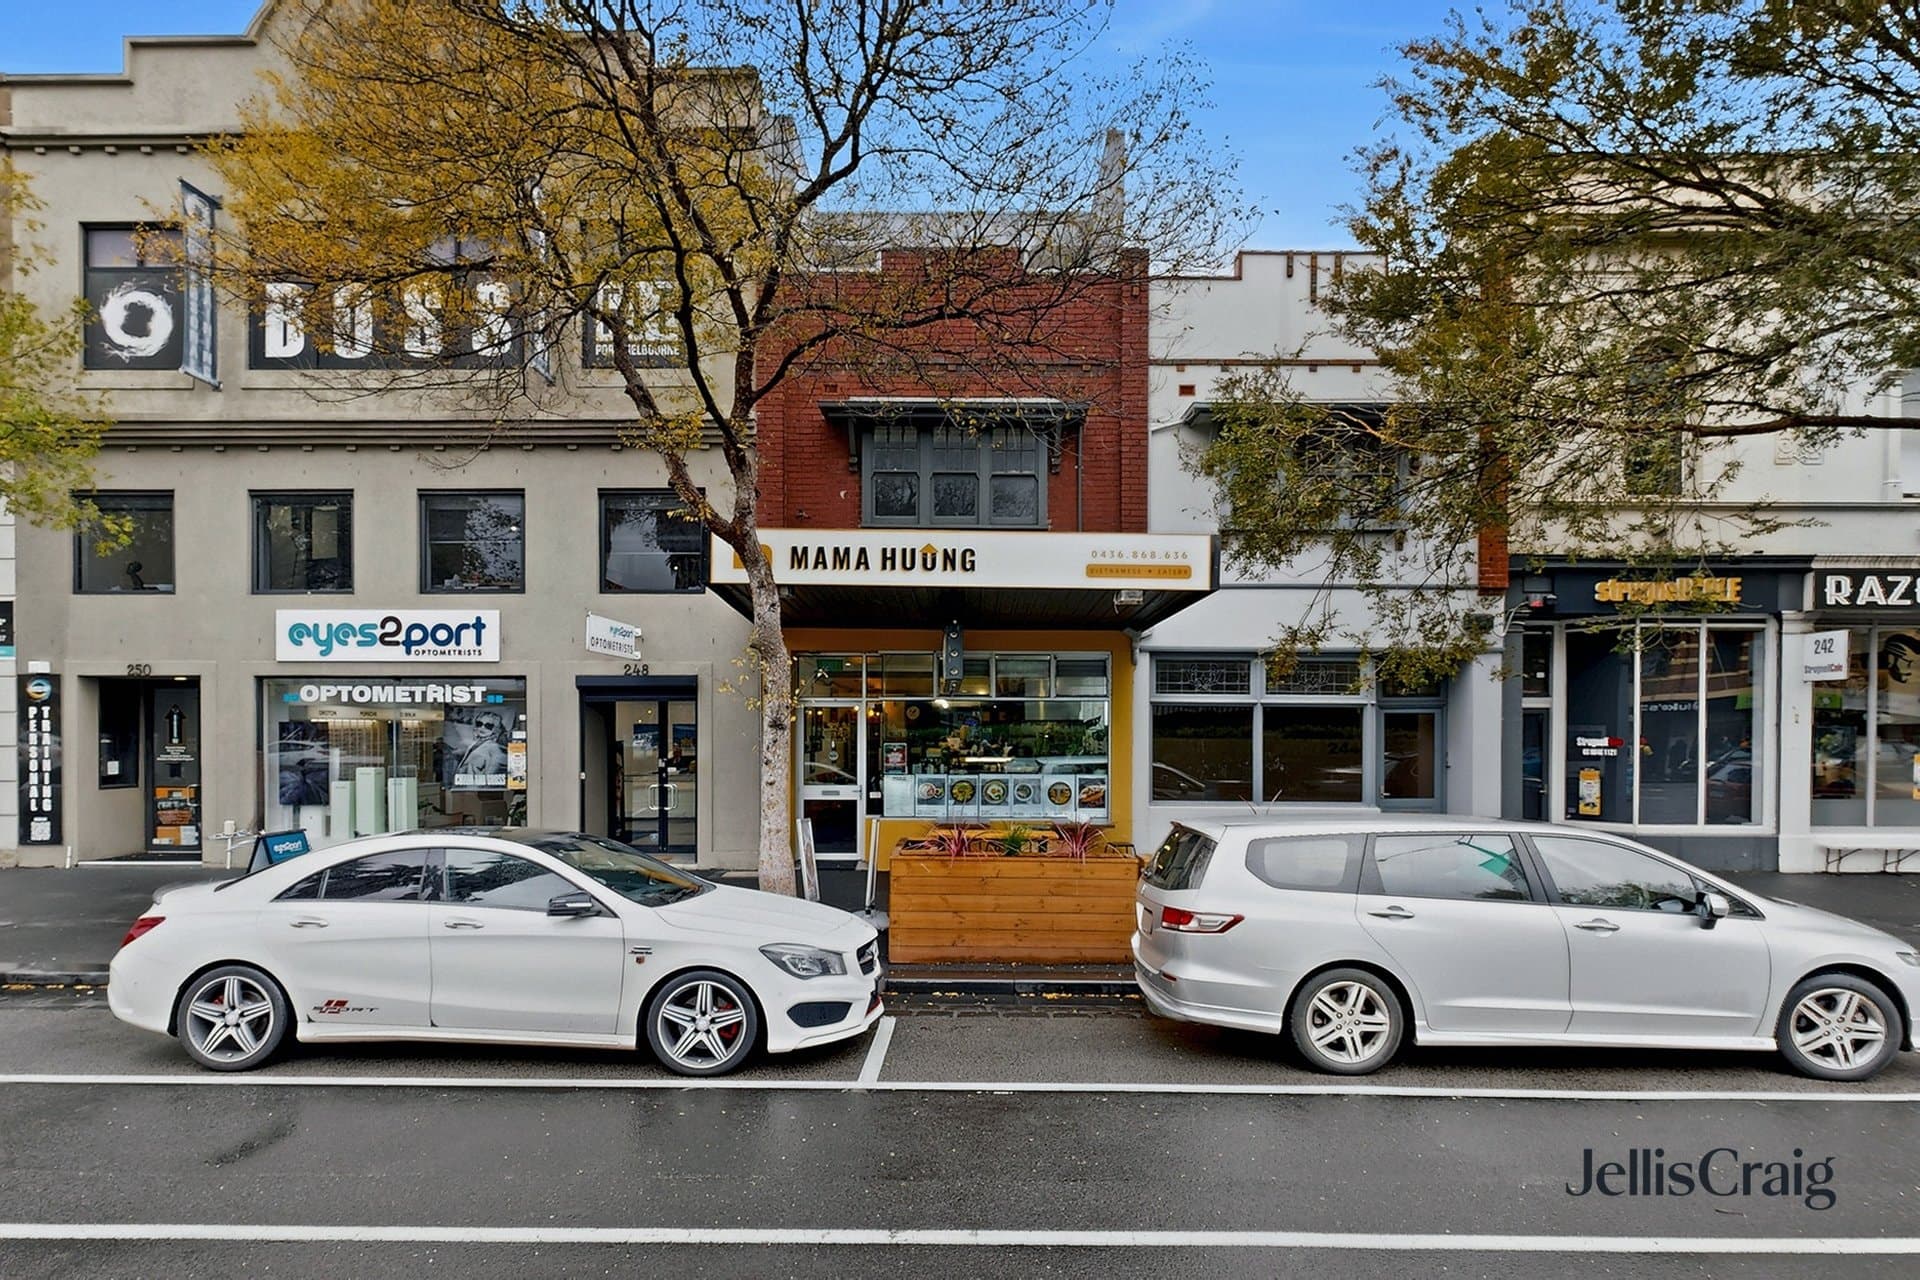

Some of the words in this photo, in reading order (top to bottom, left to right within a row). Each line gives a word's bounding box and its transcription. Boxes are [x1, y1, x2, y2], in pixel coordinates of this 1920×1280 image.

[595, 344, 621, 356] POR
[626, 344, 680, 356] ELBOURNE
[790, 546, 870, 570] MAMA
[1091, 550, 1188, 560] 0436.868.636
[1824, 575, 1920, 605] RAZ
[288, 616, 486, 657] eyes2port
[414, 649, 482, 657] OPTOMETRISTS
[591, 636, 634, 655] OPTOMETRISTS
[1814, 639, 1834, 655] 242
[127, 664, 151, 677] 250
[624, 664, 649, 677] 248
[300, 684, 487, 703] OPTOMETRIST
